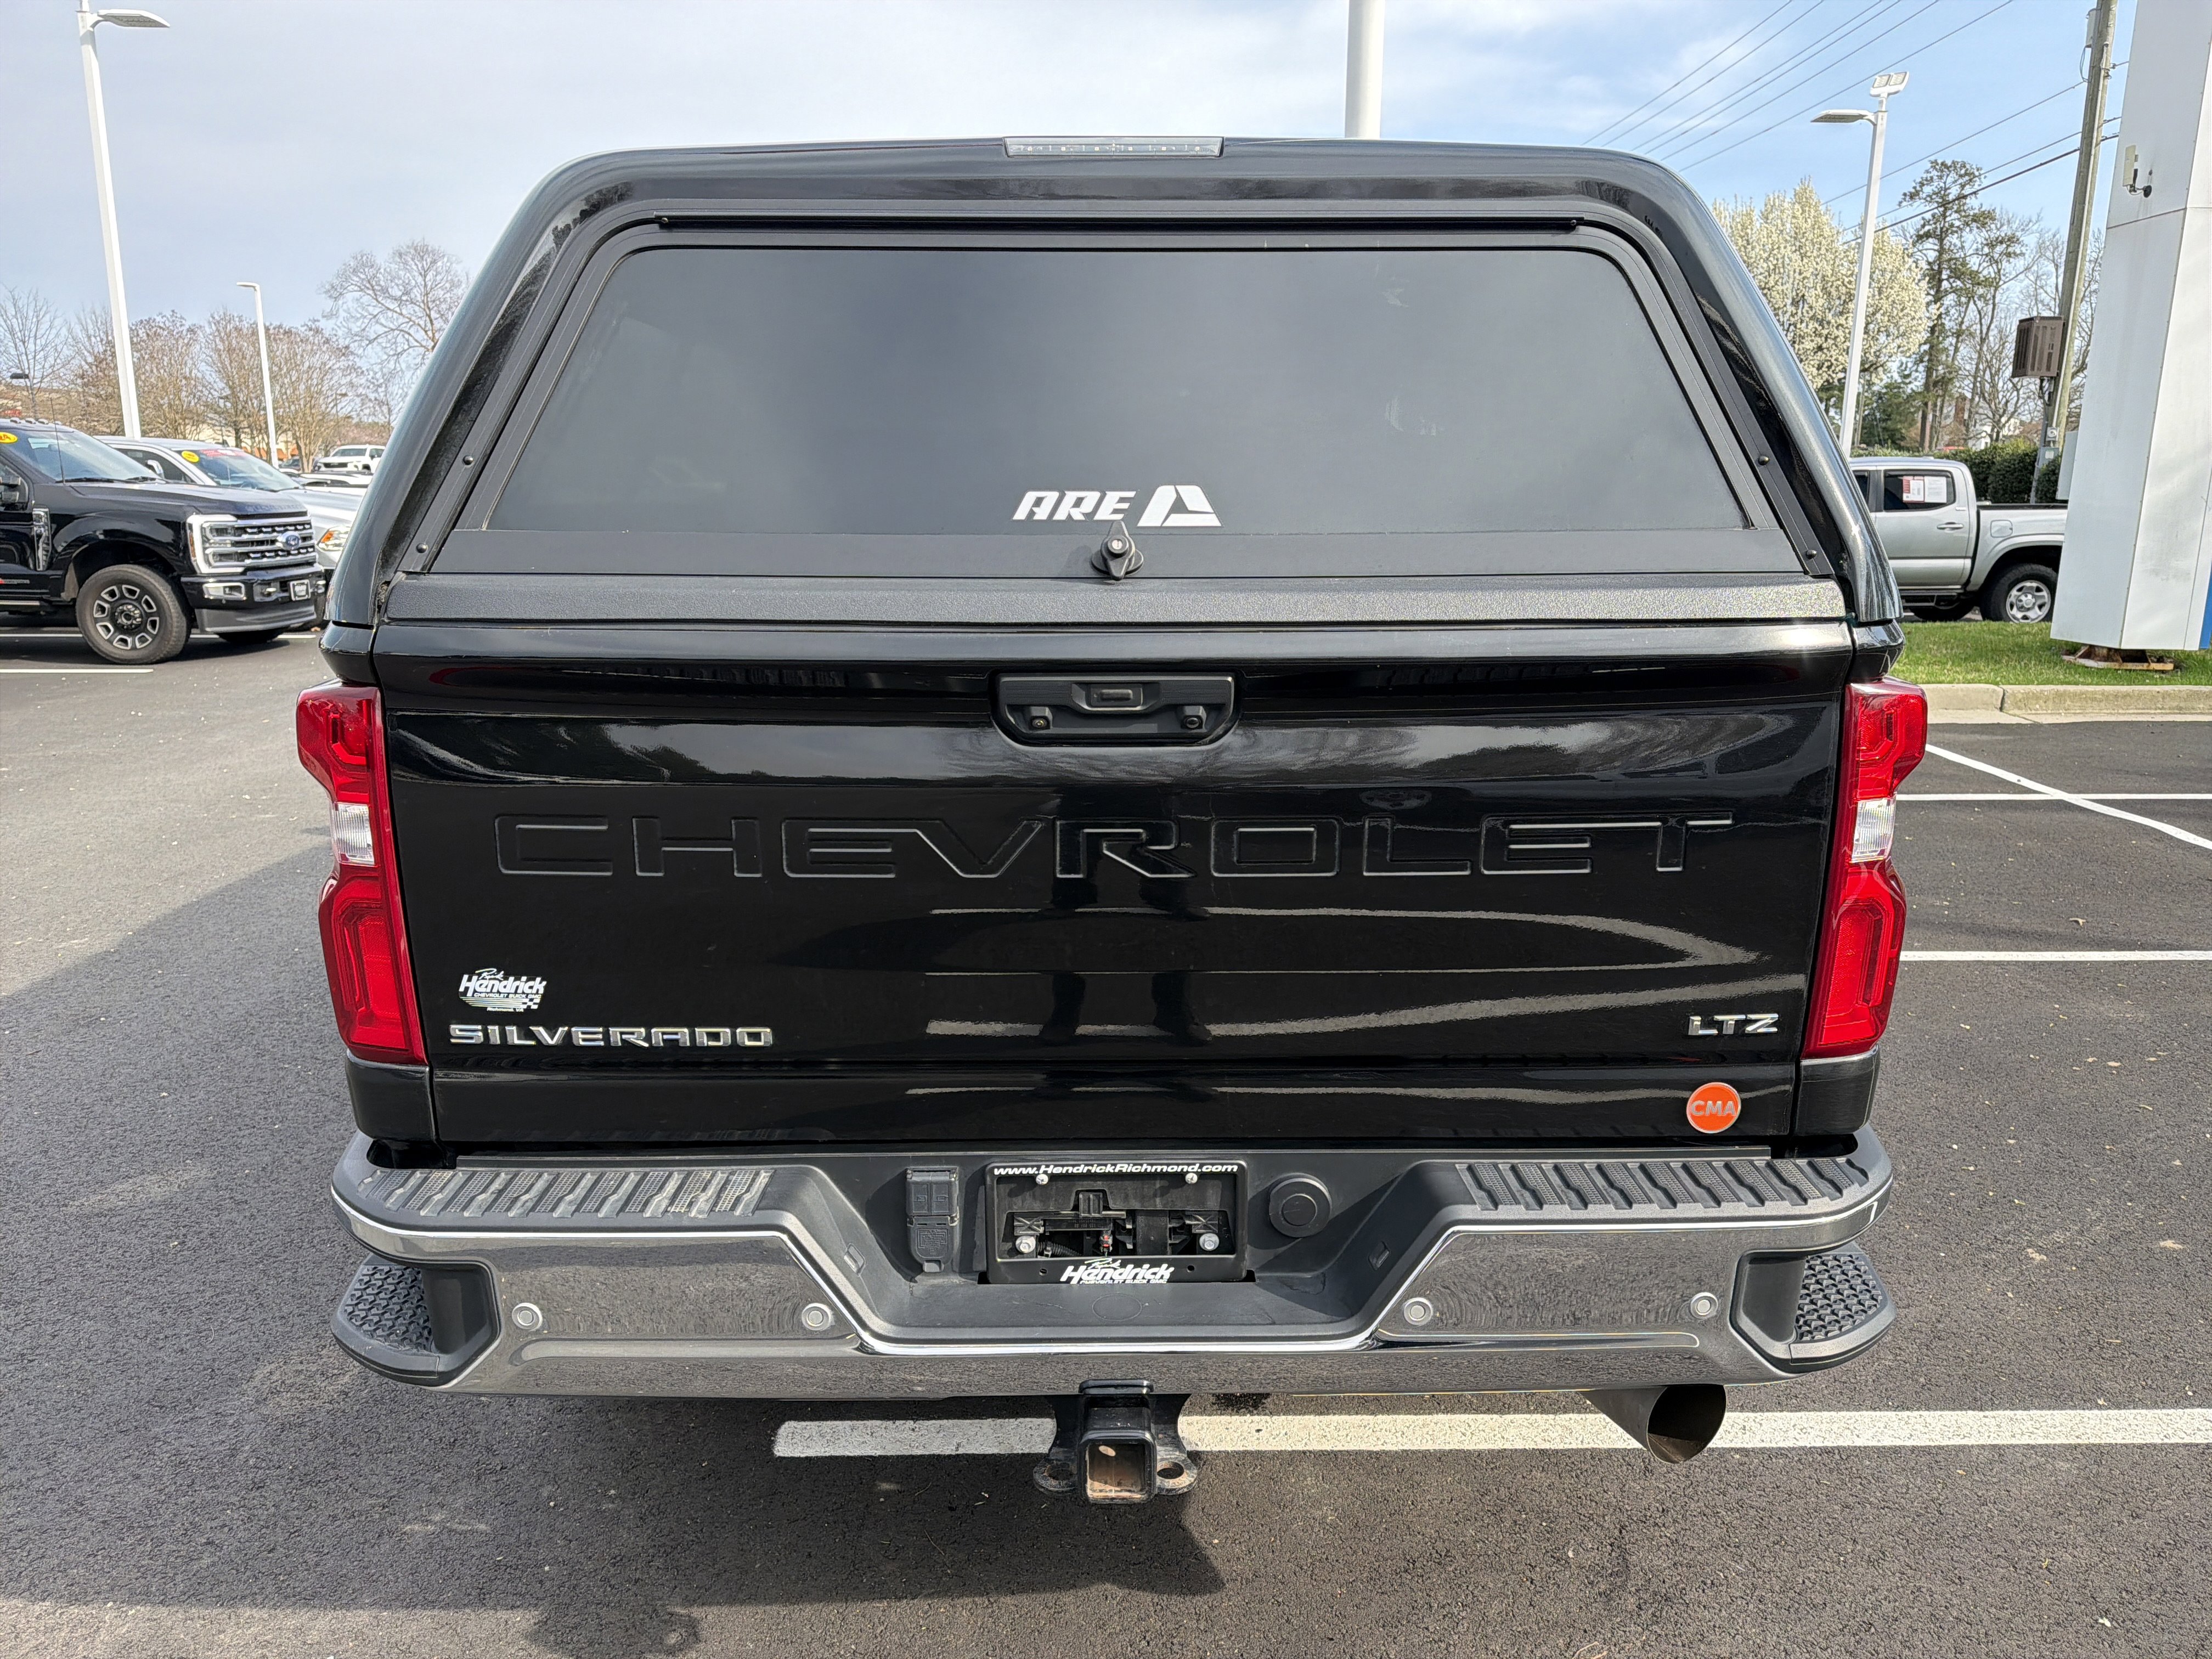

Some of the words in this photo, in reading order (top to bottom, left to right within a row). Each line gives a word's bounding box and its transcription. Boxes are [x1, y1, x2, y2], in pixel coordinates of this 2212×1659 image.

[1012, 490, 1136, 521] ARE
[494, 813, 1734, 881] CHEVROLET
[459, 974, 547, 997] Hendrick
[449, 1024, 774, 1047] SILVERADO
[1688, 1013, 1779, 1036] LTZ
[1691, 1101, 1736, 1116] CMA
[994, 1163, 1239, 1175] www.HendrickRichmond.com
[1060, 1264, 1175, 1284] Hendrick
